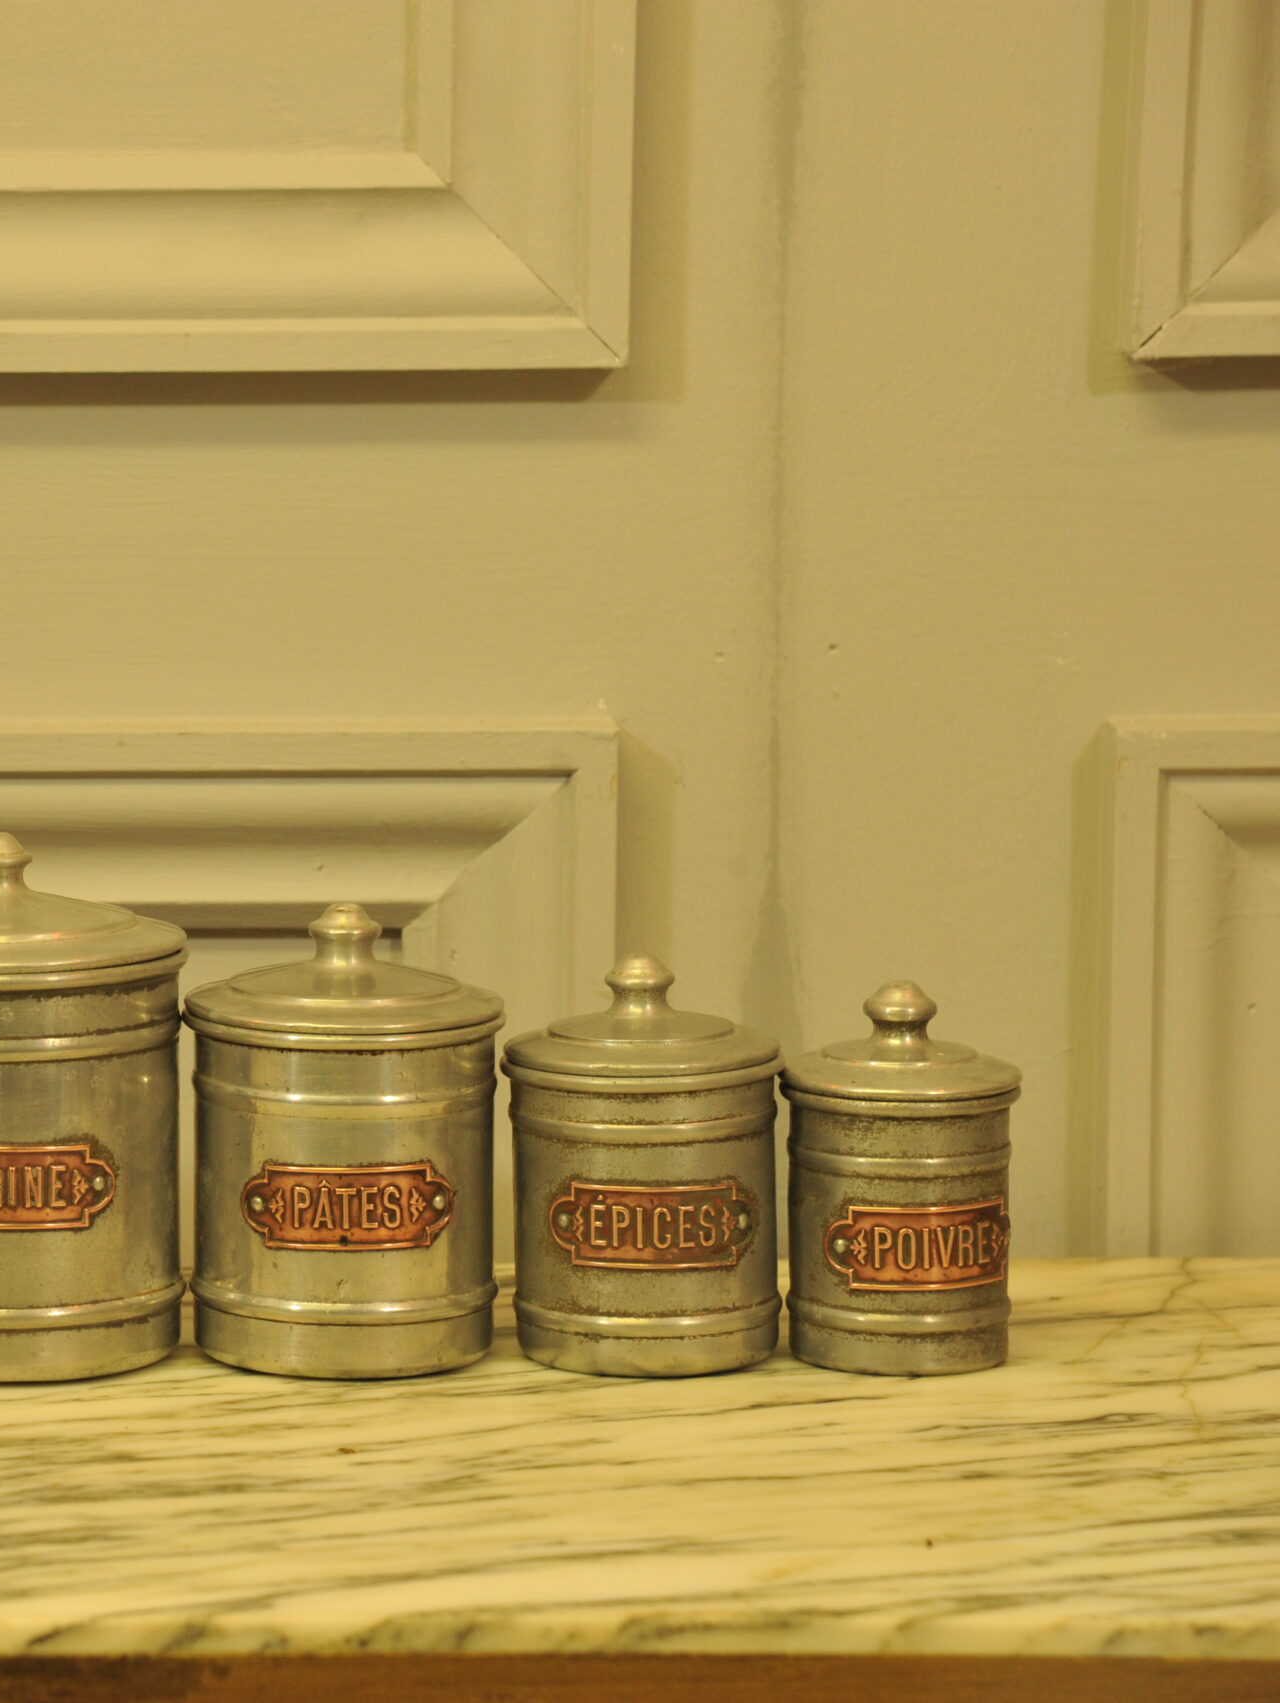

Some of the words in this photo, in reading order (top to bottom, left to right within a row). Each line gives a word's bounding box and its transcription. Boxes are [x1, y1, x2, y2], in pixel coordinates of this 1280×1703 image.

[293, 1180, 401, 1230] PÂTES
[590, 1194, 716, 1249] ÉPICES
[874, 1221, 991, 1270] POIVRE
